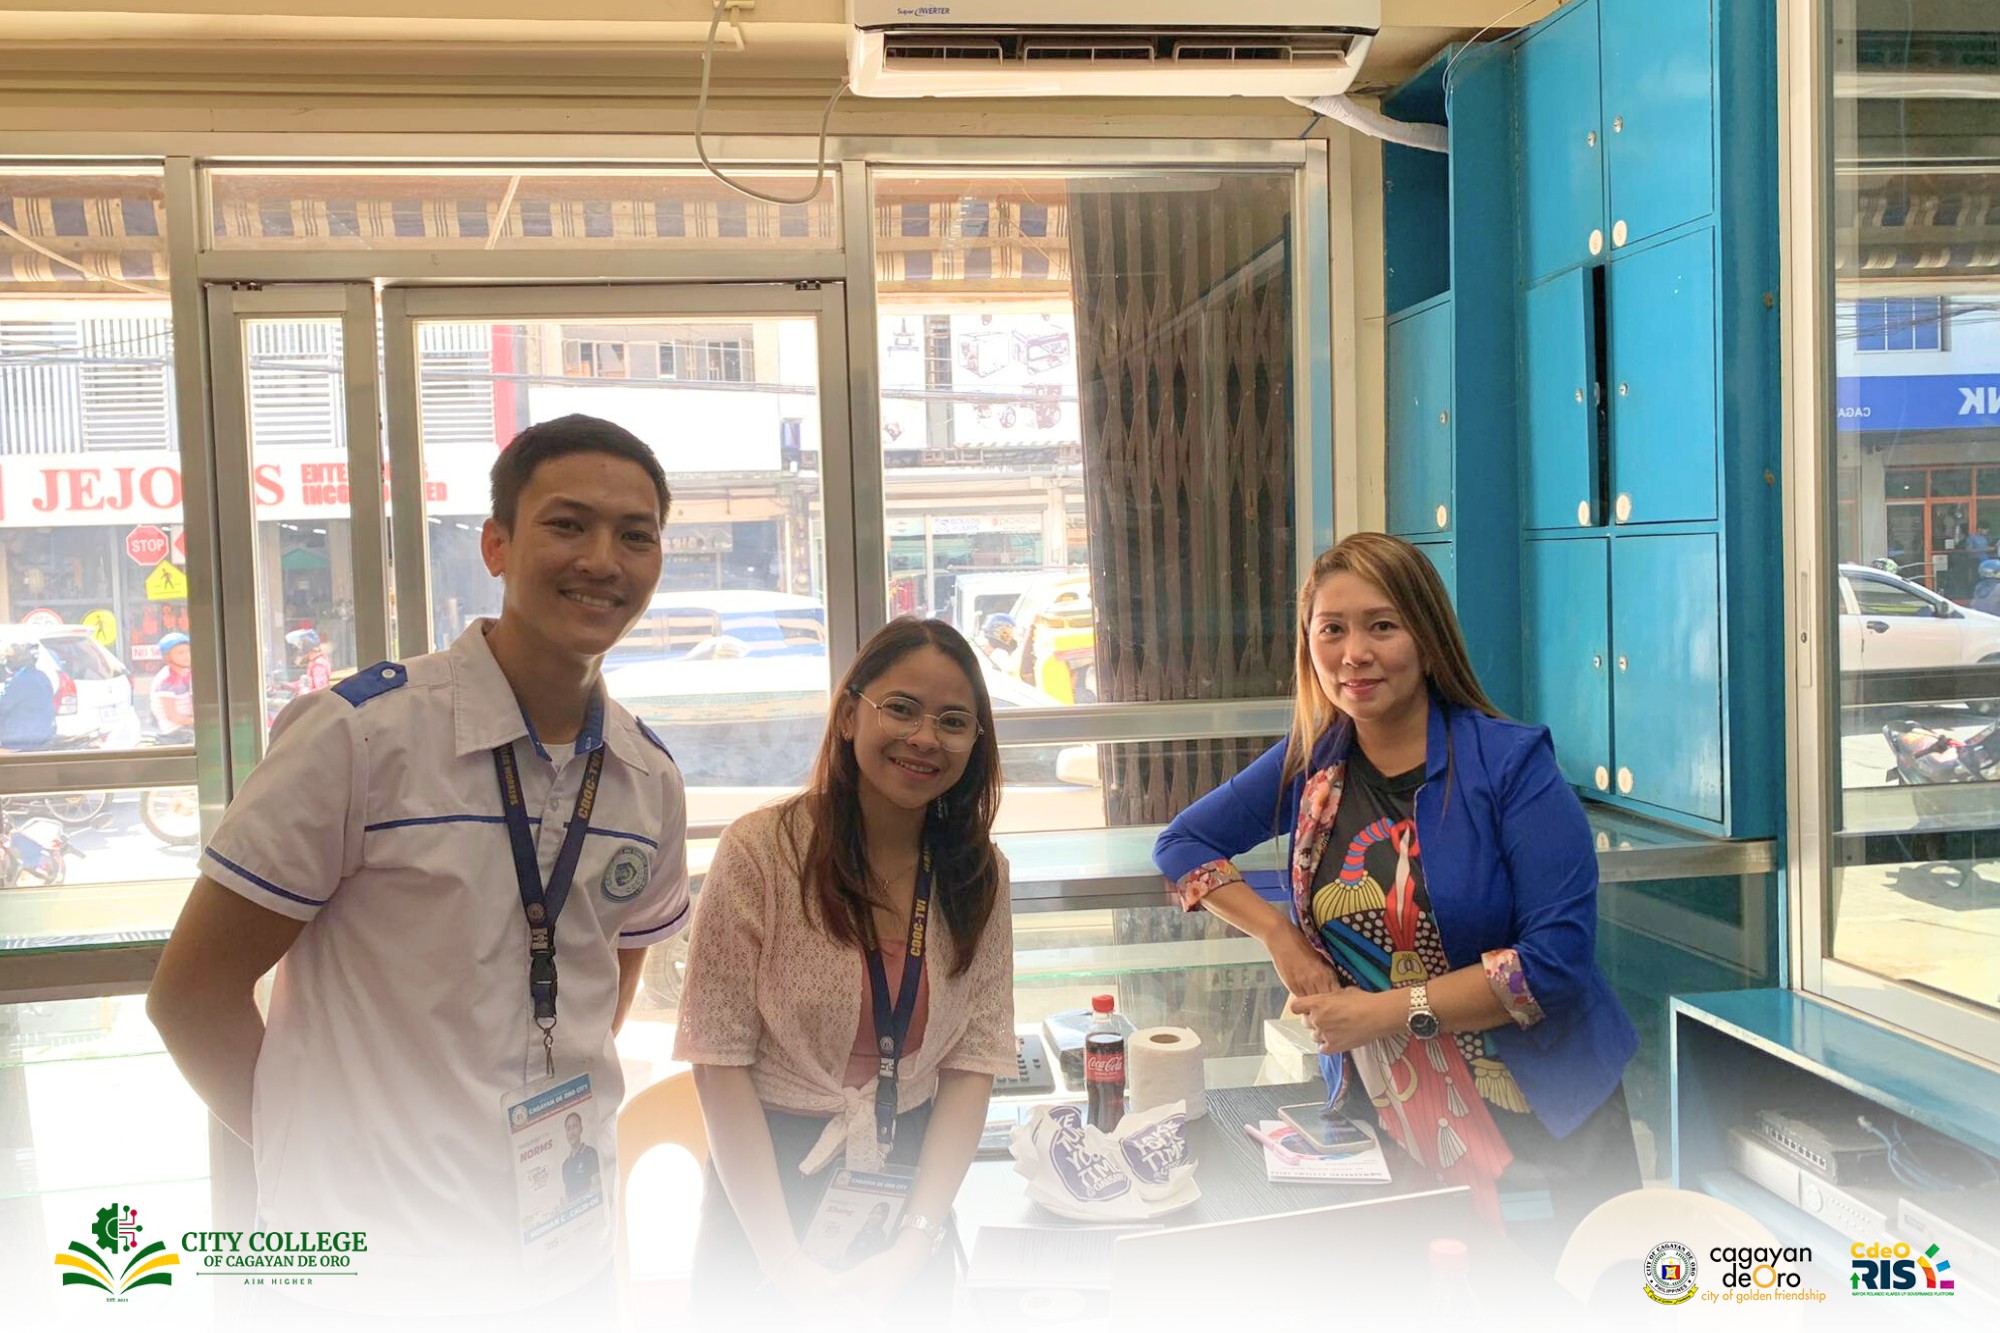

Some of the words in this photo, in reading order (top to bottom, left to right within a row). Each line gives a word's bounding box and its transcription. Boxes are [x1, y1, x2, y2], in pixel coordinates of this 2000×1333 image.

[31, 463, 286, 512] JEJOS
[131, 539, 165, 553] STOP
[520, 1139, 553, 1163] NORMS
[1077, 1158, 1123, 1188] TIM
